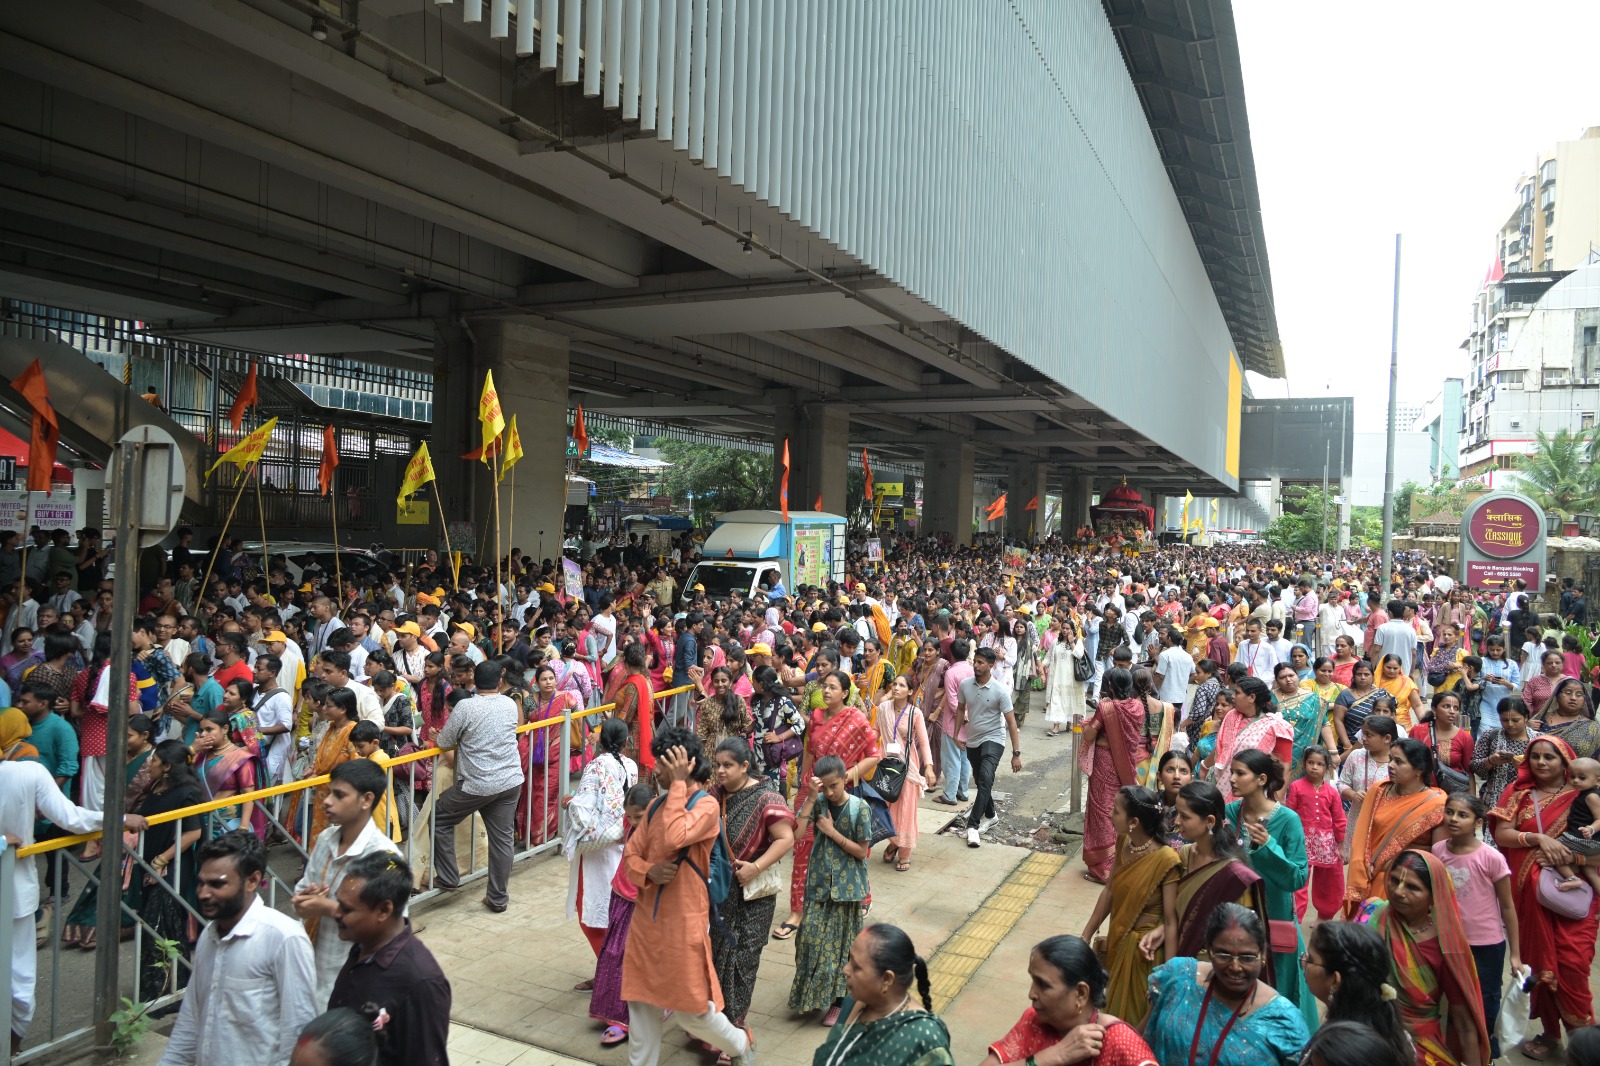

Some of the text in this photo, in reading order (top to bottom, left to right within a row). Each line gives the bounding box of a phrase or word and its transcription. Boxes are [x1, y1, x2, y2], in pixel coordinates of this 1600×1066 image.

[37, 510, 49, 518] BUY
[1486, 512, 1522, 521] क्लासिक
[36, 519, 72, 527] TEA/COFFEE
[1485, 531, 1522, 541] CLASSIQUE
